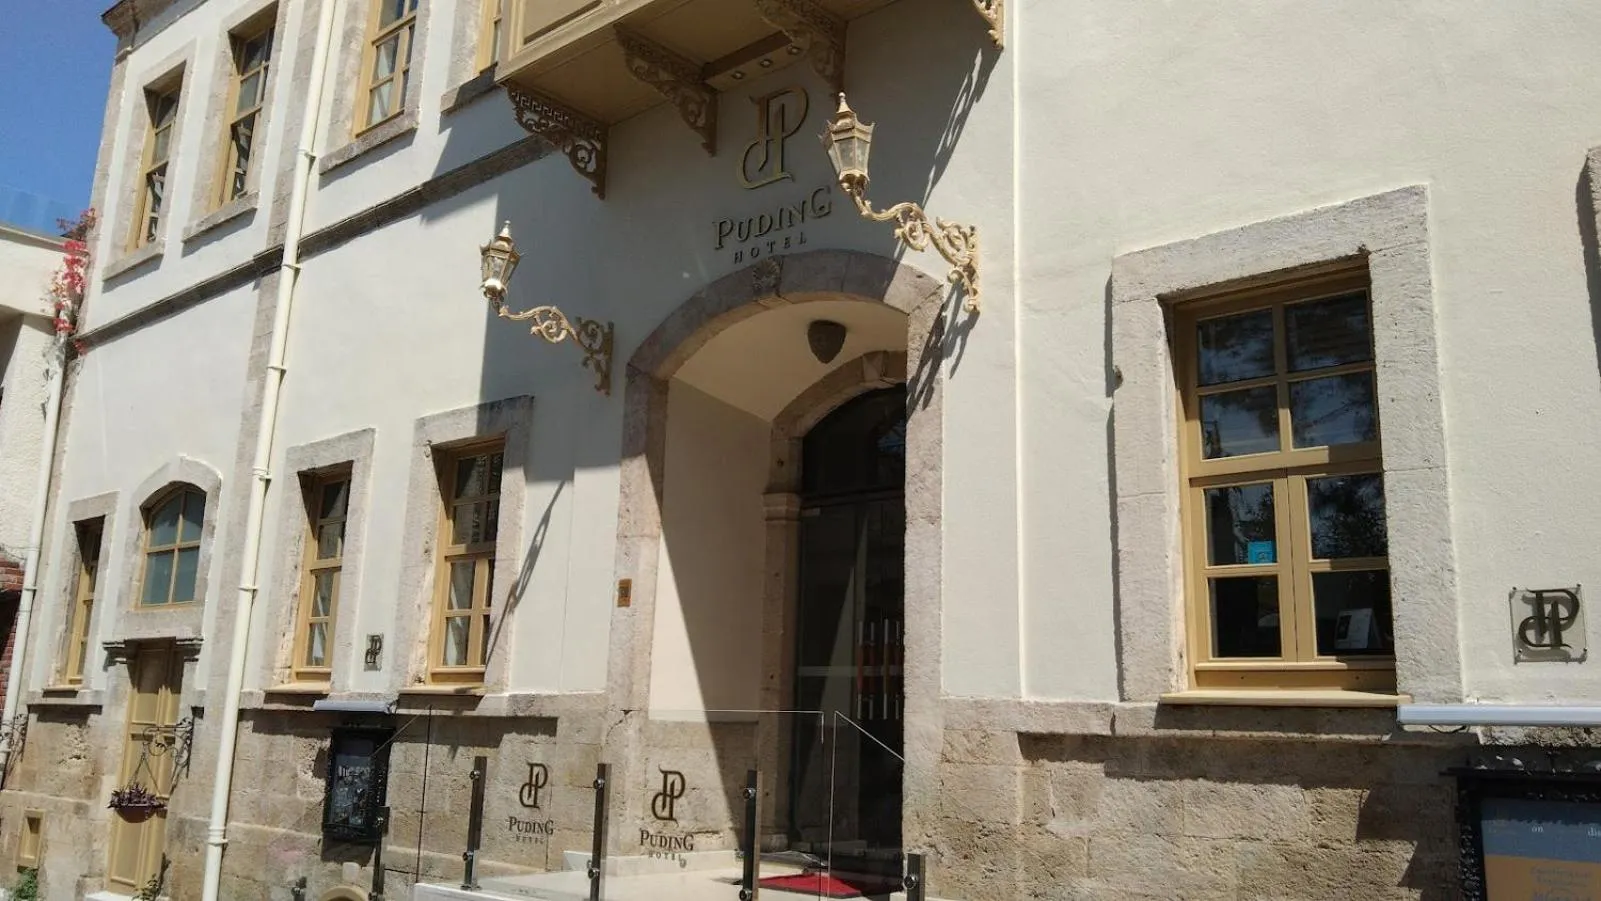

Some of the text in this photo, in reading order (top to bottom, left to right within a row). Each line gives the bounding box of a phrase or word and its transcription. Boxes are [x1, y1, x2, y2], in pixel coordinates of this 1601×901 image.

[712, 185, 832, 250] PUDING
[733, 231, 808, 264] HOTEL
[508, 816, 554, 836] PUDING
[639, 828, 695, 852] PUDING
